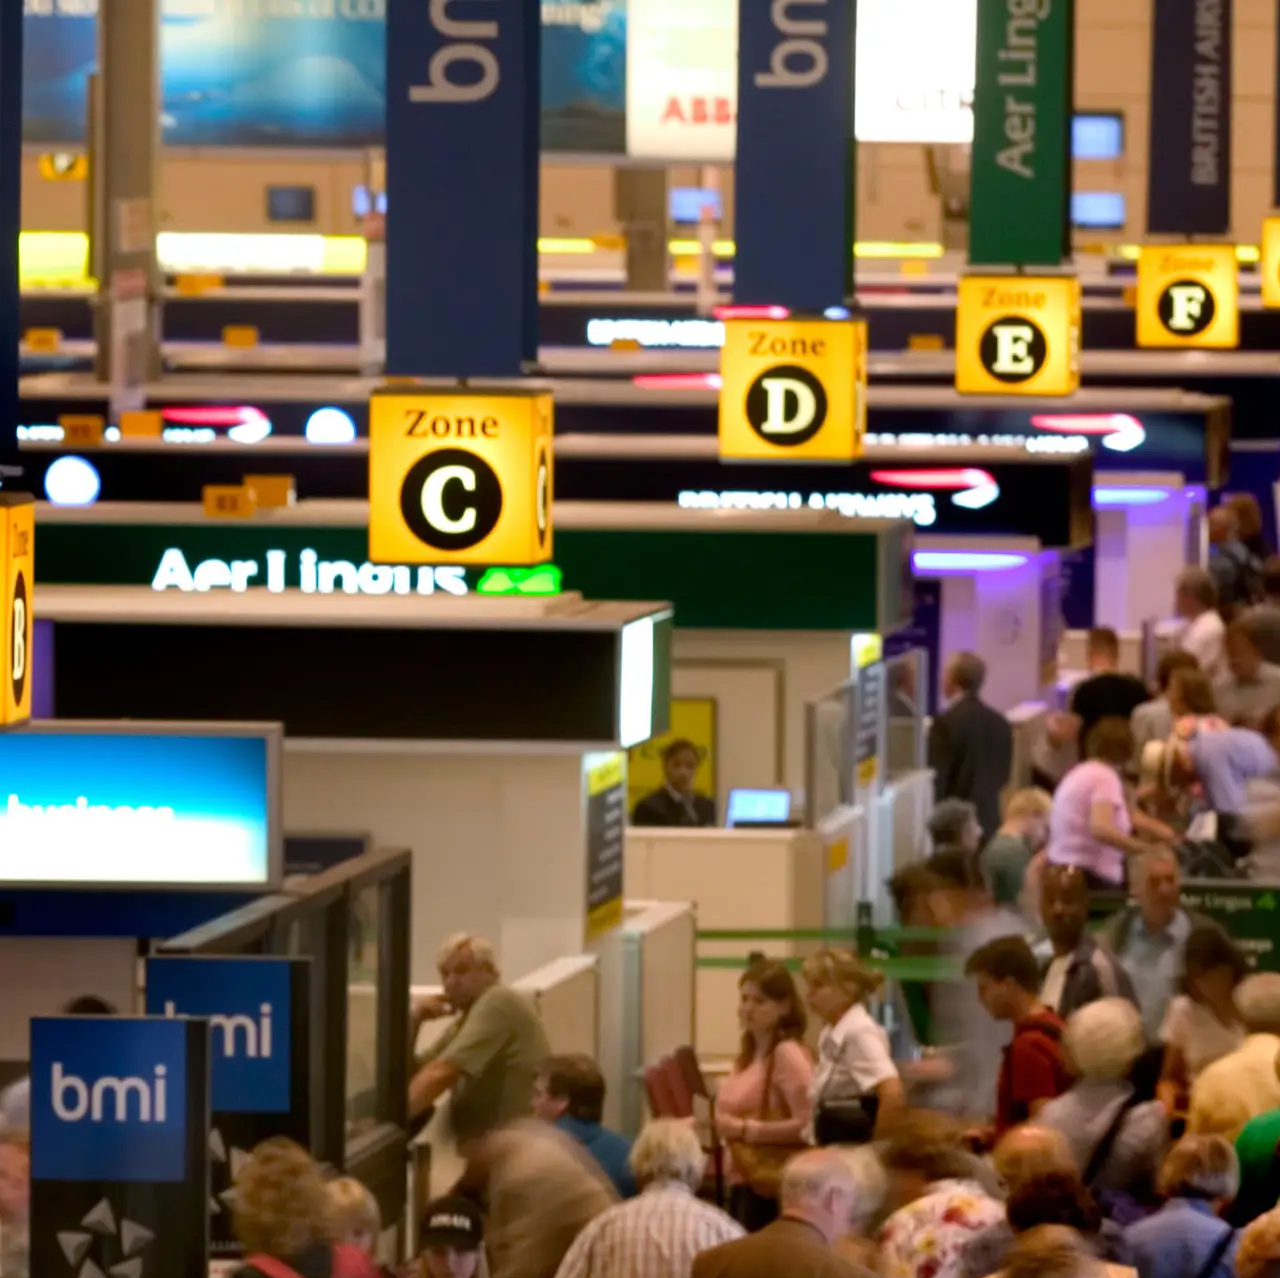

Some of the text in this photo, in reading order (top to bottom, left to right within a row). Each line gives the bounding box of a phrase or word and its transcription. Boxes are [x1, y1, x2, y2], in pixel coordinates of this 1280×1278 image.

[995, 96, 1036, 178] Aer
[1190, 64, 1222, 185] BRITISH
[980, 285, 1048, 310] Zone
[1167, 280, 1207, 330] F
[748, 332, 826, 358] Zone
[992, 326, 1035, 374] E
[405, 409, 499, 439] Zone
[760, 378, 817, 434] D
[420, 465, 478, 534] C
[151, 548, 258, 592] Aer
[12, 597, 26, 681] B
[51, 1062, 167, 1123] bmi
